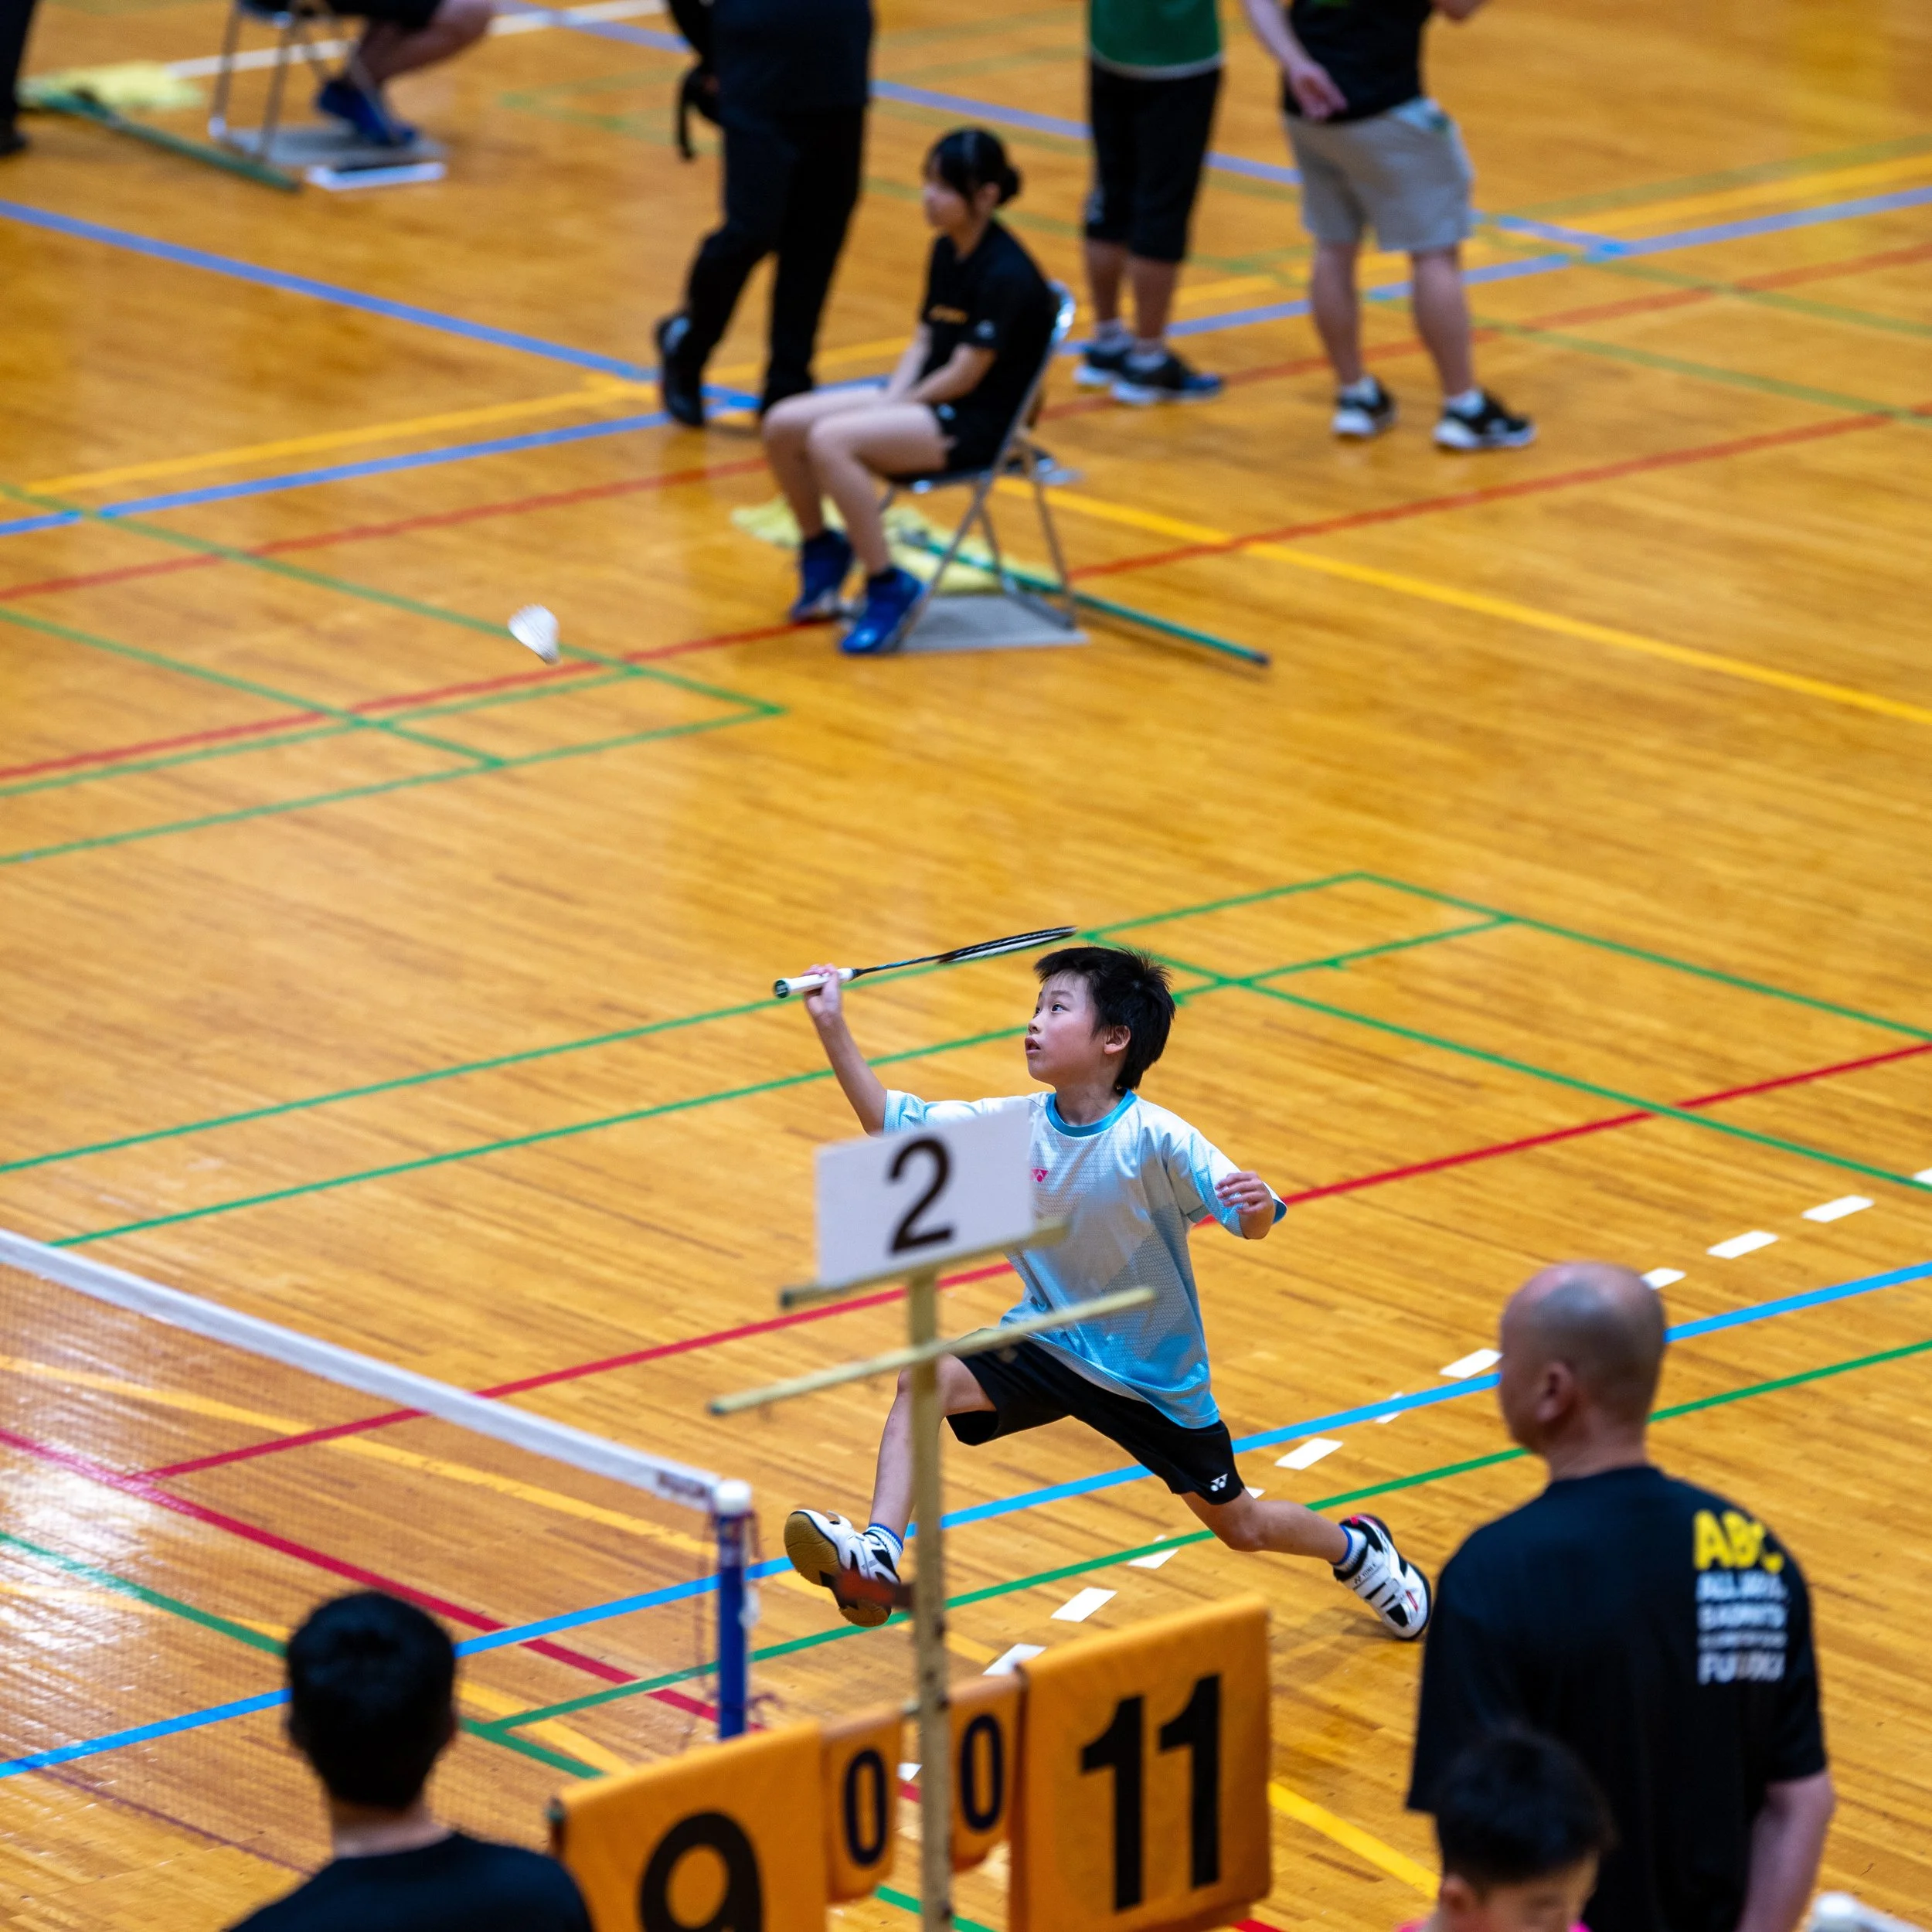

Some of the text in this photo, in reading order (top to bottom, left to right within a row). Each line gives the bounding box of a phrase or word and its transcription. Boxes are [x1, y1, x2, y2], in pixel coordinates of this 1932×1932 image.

[887, 1136, 954, 1257] 2
[842, 1747, 889, 1867] 0
[957, 1713, 1005, 1833] 0
[1079, 1672, 1223, 1914] 11
[638, 1810, 764, 1932] 9
